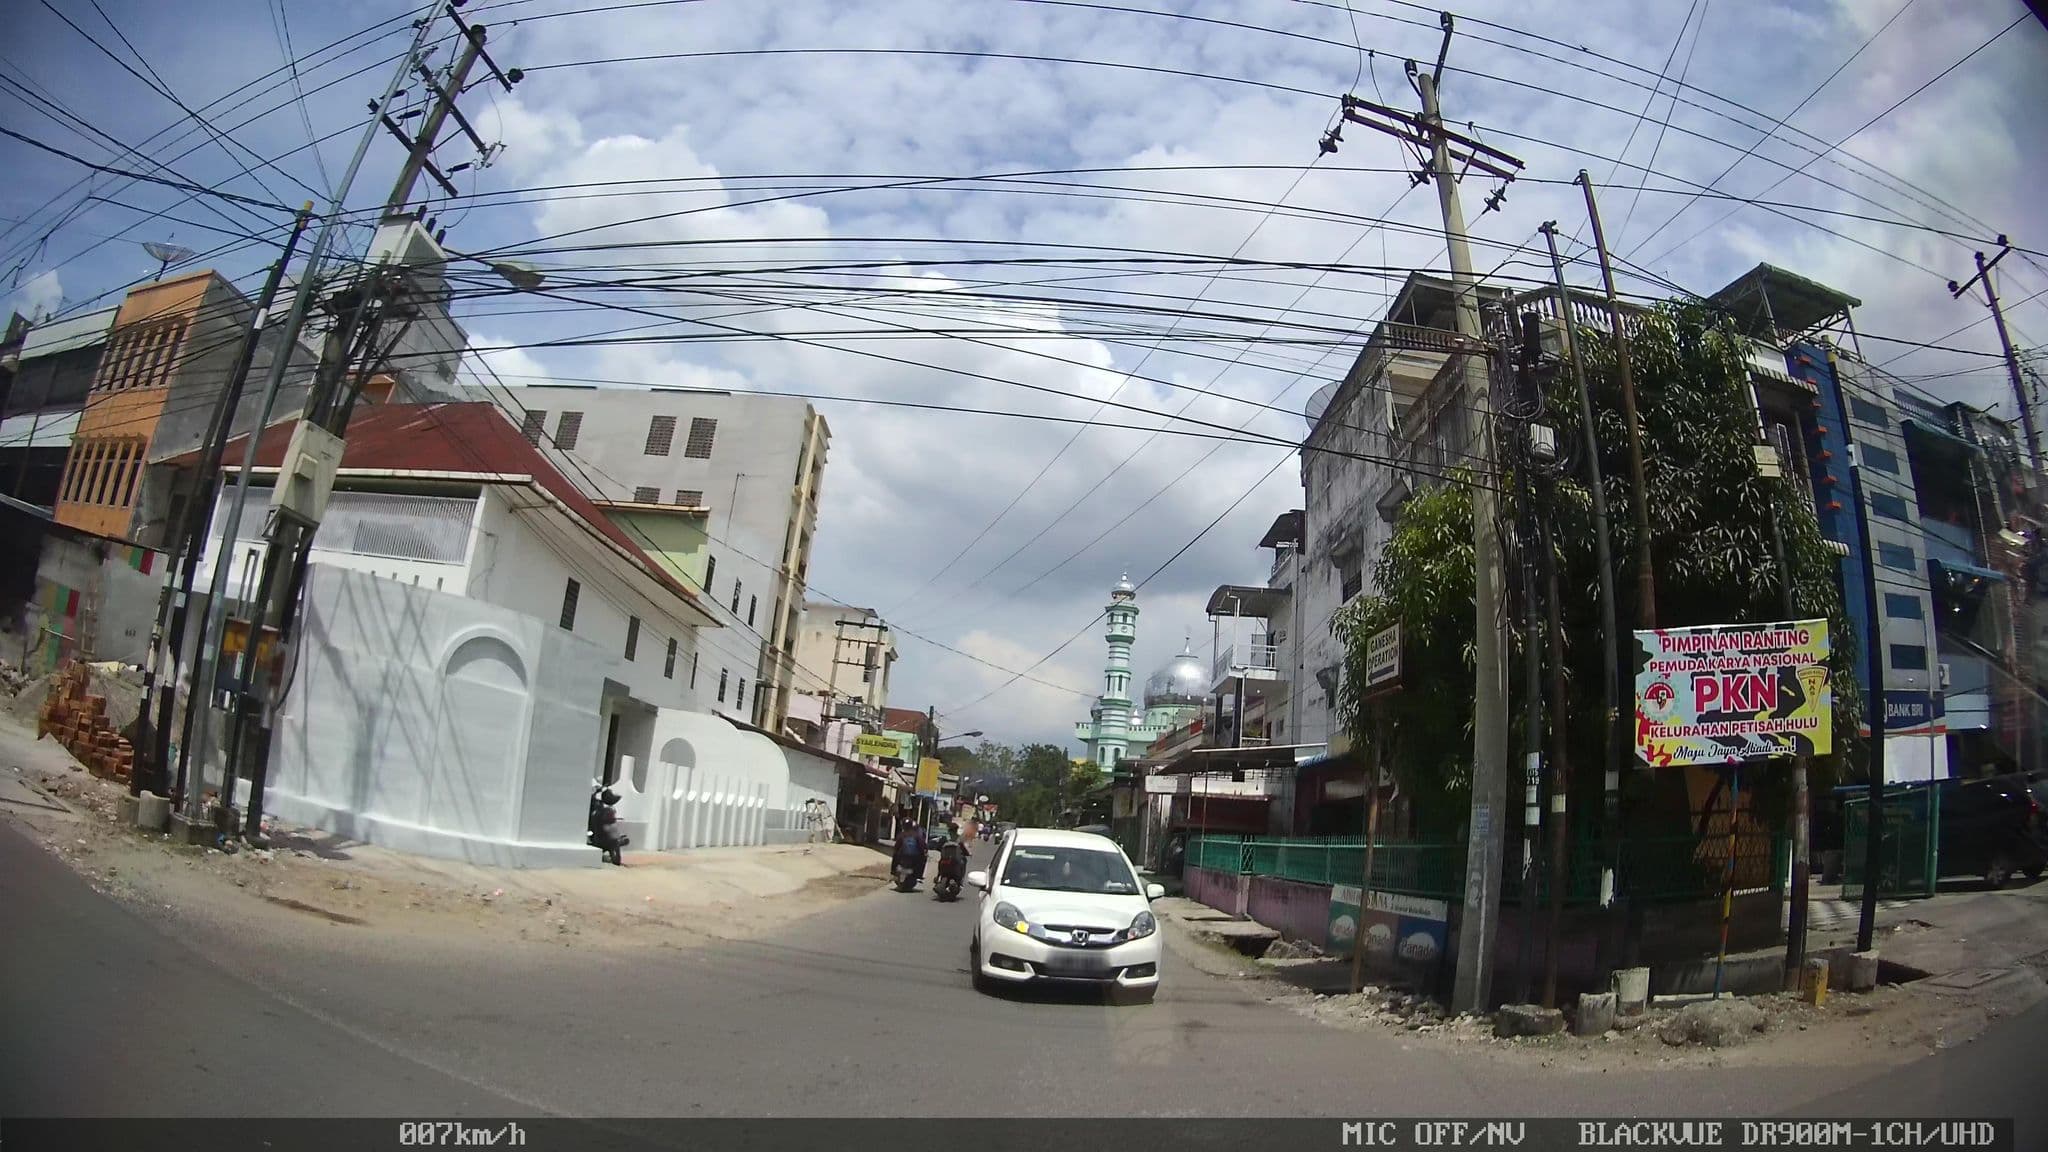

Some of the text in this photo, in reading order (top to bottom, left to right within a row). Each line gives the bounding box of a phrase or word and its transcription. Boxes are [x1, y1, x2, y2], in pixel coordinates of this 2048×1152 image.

[1370, 630, 1397, 653] GANESHA
[1661, 629, 1809, 653] PIMPINAN RANTING
[1367, 643, 1399, 671] OPERATION
[1650, 653, 1817, 672] PEMUDA KARYA NASIONAL
[1694, 674, 1777, 713] PKN
[1888, 703, 1924, 717] BANK BRI
[1650, 717, 1818, 738] KELURAHAN PETISAH HULU
[1673, 745, 1705, 760] Maju
[1708, 743, 1738, 759] Jaya
